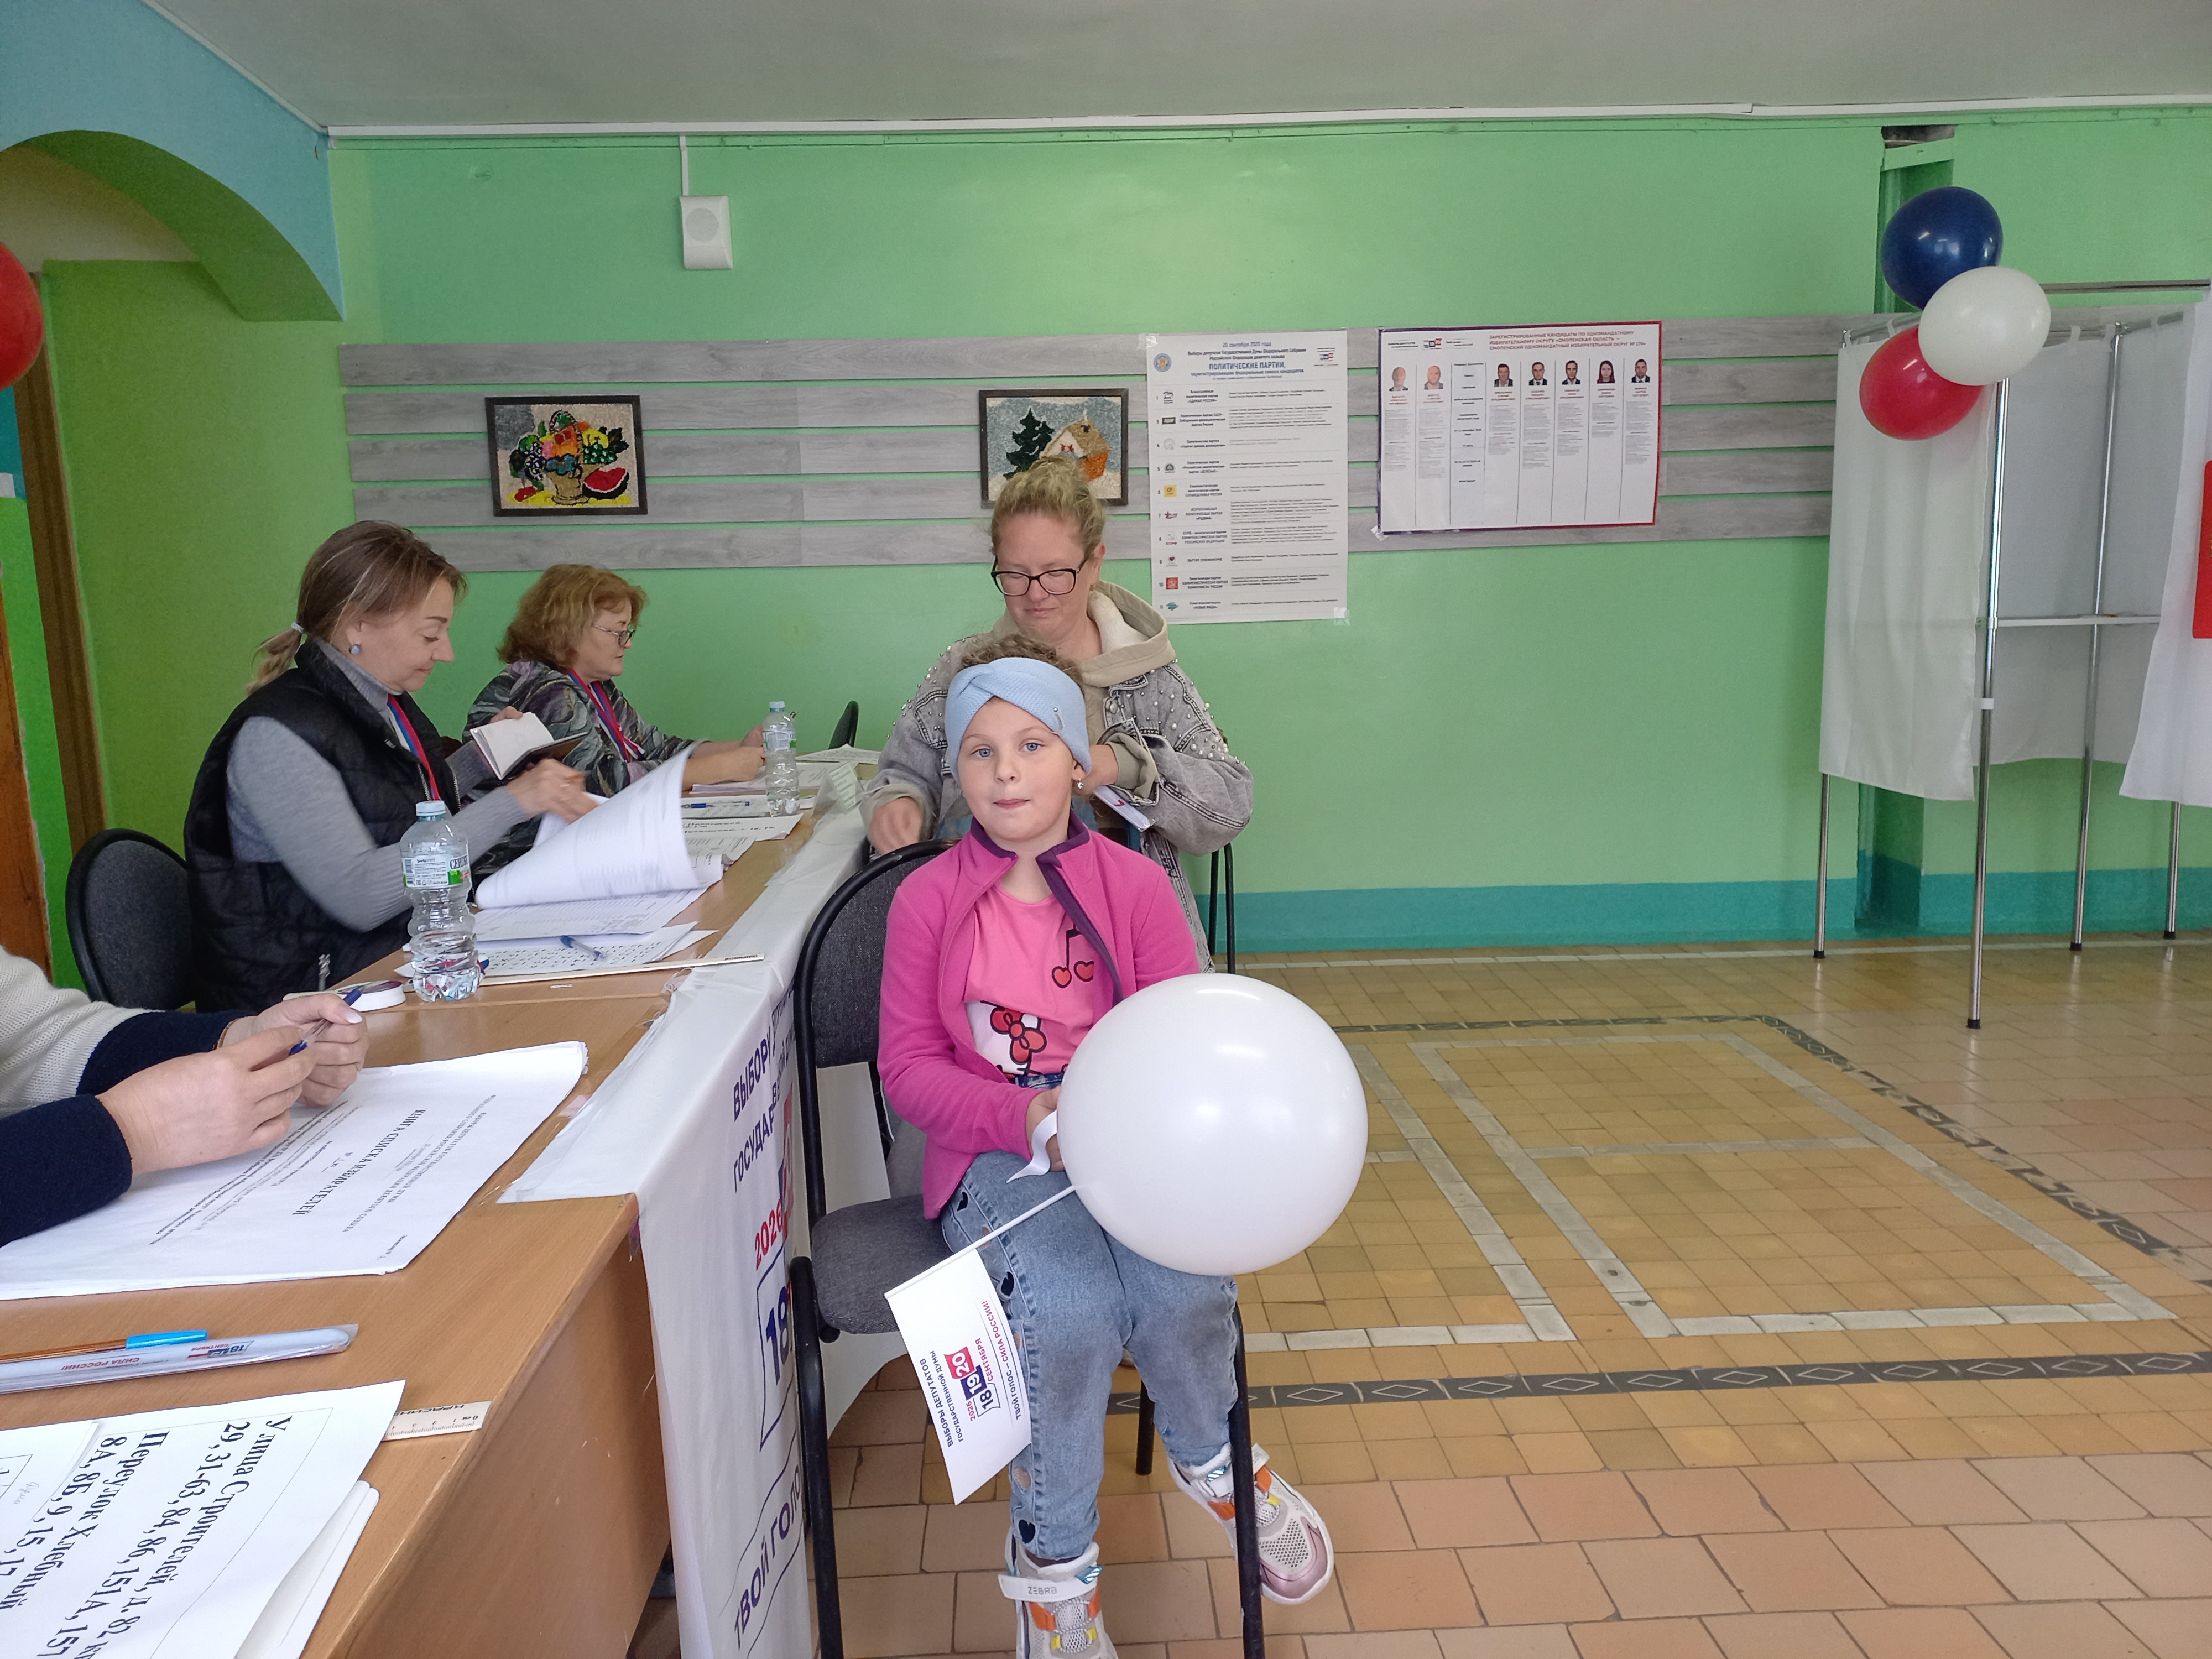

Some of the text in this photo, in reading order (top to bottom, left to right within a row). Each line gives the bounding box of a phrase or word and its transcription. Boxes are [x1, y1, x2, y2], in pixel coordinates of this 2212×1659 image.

[393, 1109, 426, 1131] КНИГА
[359, 1133, 399, 1163] СПИСКА
[293, 1164, 367, 1215] ИЗБИРАТЕЛЕЙ
[755, 1198, 782, 1271] 2026
[982, 1300, 1001, 1338] РОССИИ!
[191, 1343, 229, 1352] СЕНТЯБРЯ
[229, 1344, 245, 1354] 18
[766, 1286, 790, 1386] 18
[998, 1338, 1008, 1362] СИЛА
[61, 1361, 109, 1371] РОССИИ!
[952, 1352, 970, 1377] 20
[975, 1338, 993, 1381] СЕНТЯБРЯ
[930, 1350, 963, 1442] ГОСУДАРСТВЕННОЙ ДУМЫ
[967, 1373, 982, 1396] 19
[1006, 1370, 1018, 1398] ГОЛОС
[920, 1358, 953, 1447] ВЫБОРЫ ДЕПУТАТОВ
[966, 1401, 975, 1421] 2026
[980, 1389, 993, 1410] 18
[1012, 1399, 1021, 1420] ТВОЙ
[209, 1421, 251, 1449] 29,
[233, 1415, 293, 1478] Улица
[79, 1436, 127, 1469] 8А,
[51, 1472, 101, 1501] 8Б,
[78, 1431, 170, 1521] Переулок
[167, 1452, 231, 1505] 31-63,
[33, 1505, 72, 1522] 9,
[143, 1507, 191, 1535] 84,
[4, 1526, 53, 1553] 15,
[117, 1536, 166, 1564] 86,
[134, 1480, 249, 1592] Строителей,
[0, 1524, 98, 1610] Хлебный
[121, 1596, 152, 1614] д.
[734, 1534, 769, 1651] ТВОЙ
[98, 1615, 140, 1639] 82
